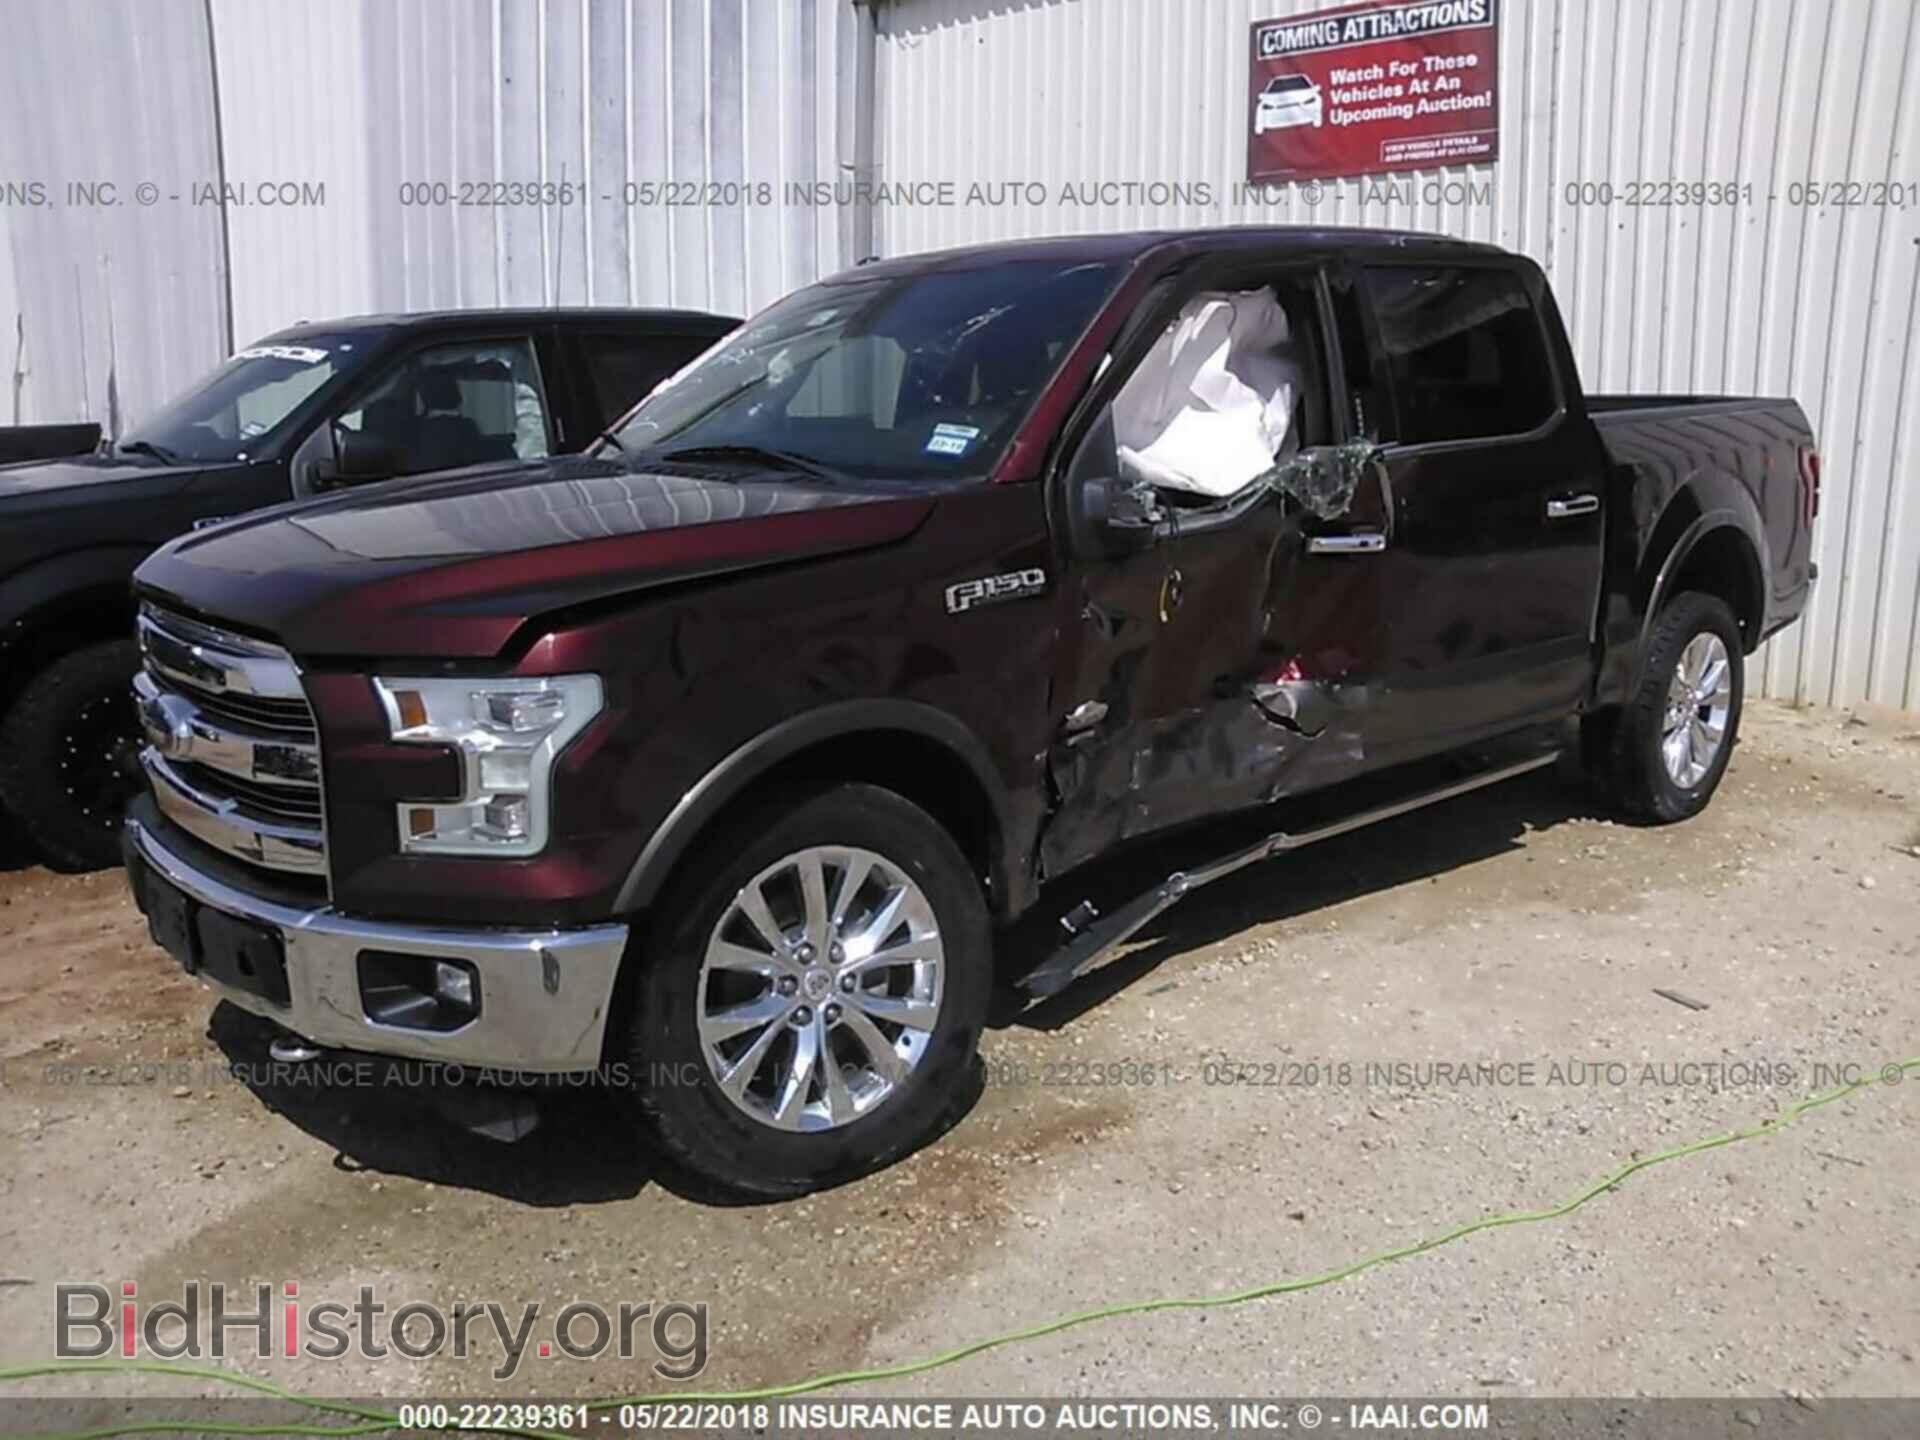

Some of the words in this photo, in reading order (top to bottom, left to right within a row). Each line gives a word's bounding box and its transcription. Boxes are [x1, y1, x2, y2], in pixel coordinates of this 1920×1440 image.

[1262, 24, 1339, 53] COMING
[1343, 0, 1487, 40] ATTRACTIONS
[1330, 63, 1384, 85] Watch
[1389, 61, 1417, 77] For
[1423, 54, 1478, 73] These
[1330, 83, 1403, 105] Vehicles
[1408, 79, 1430, 94] At
[1433, 76, 1461, 92] An
[1329, 104, 1413, 125] Upcoming
[1416, 91, 1492, 114] Auction!
